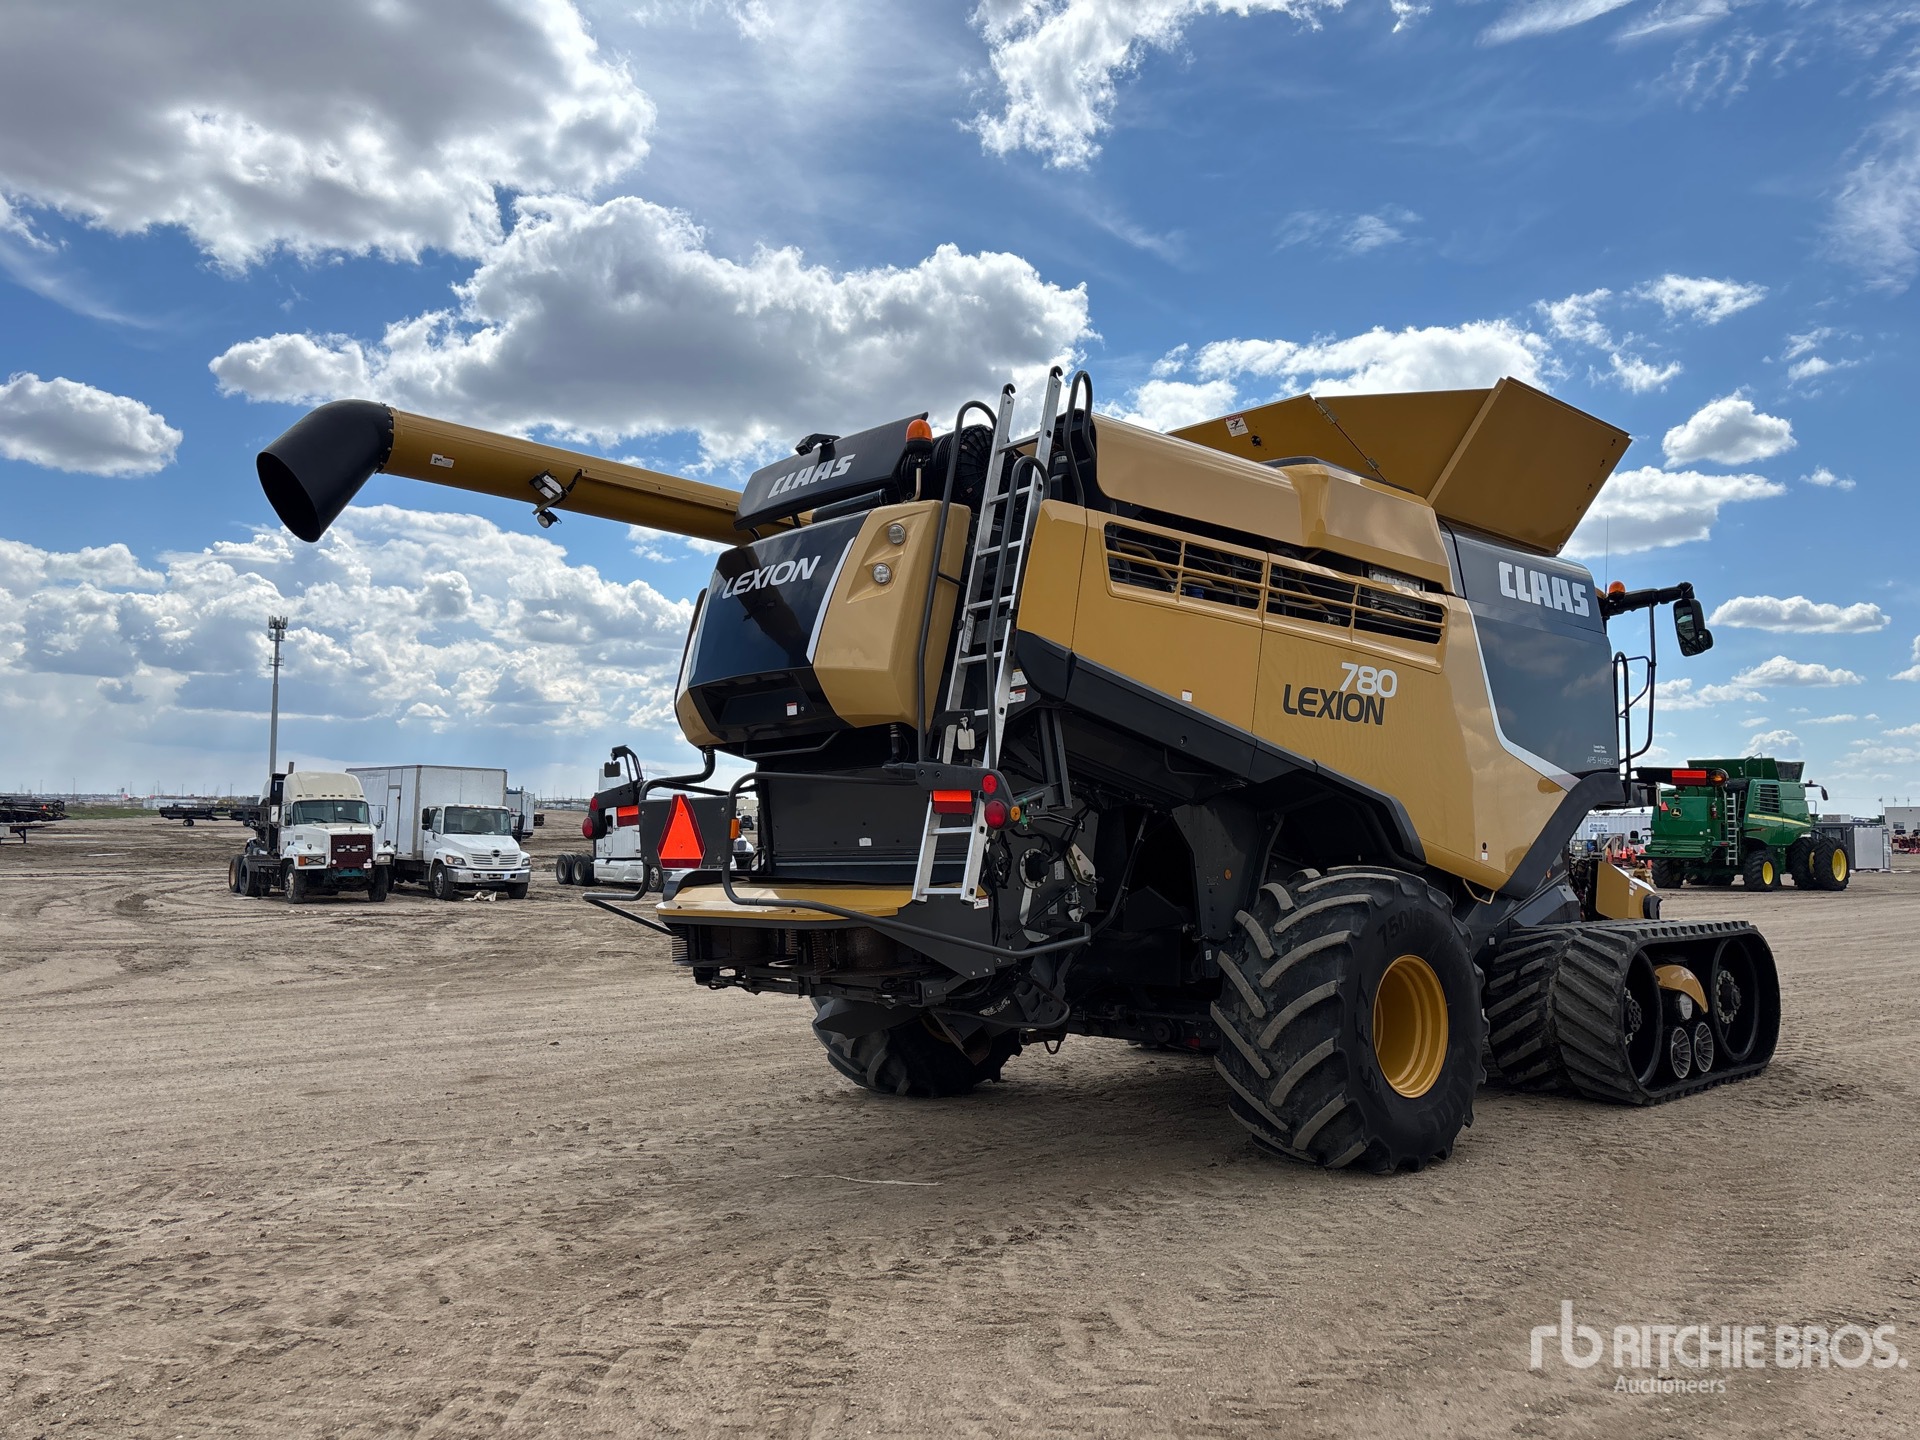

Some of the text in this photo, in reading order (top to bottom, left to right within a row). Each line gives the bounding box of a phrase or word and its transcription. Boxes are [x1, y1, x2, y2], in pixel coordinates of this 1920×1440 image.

[768, 454, 856, 499] CLAAS
[722, 555, 821, 599] LEXION
[1498, 561, 1590, 617] CLAAS
[1340, 662, 1398, 698] 780
[1283, 684, 1385, 726] LEXION
